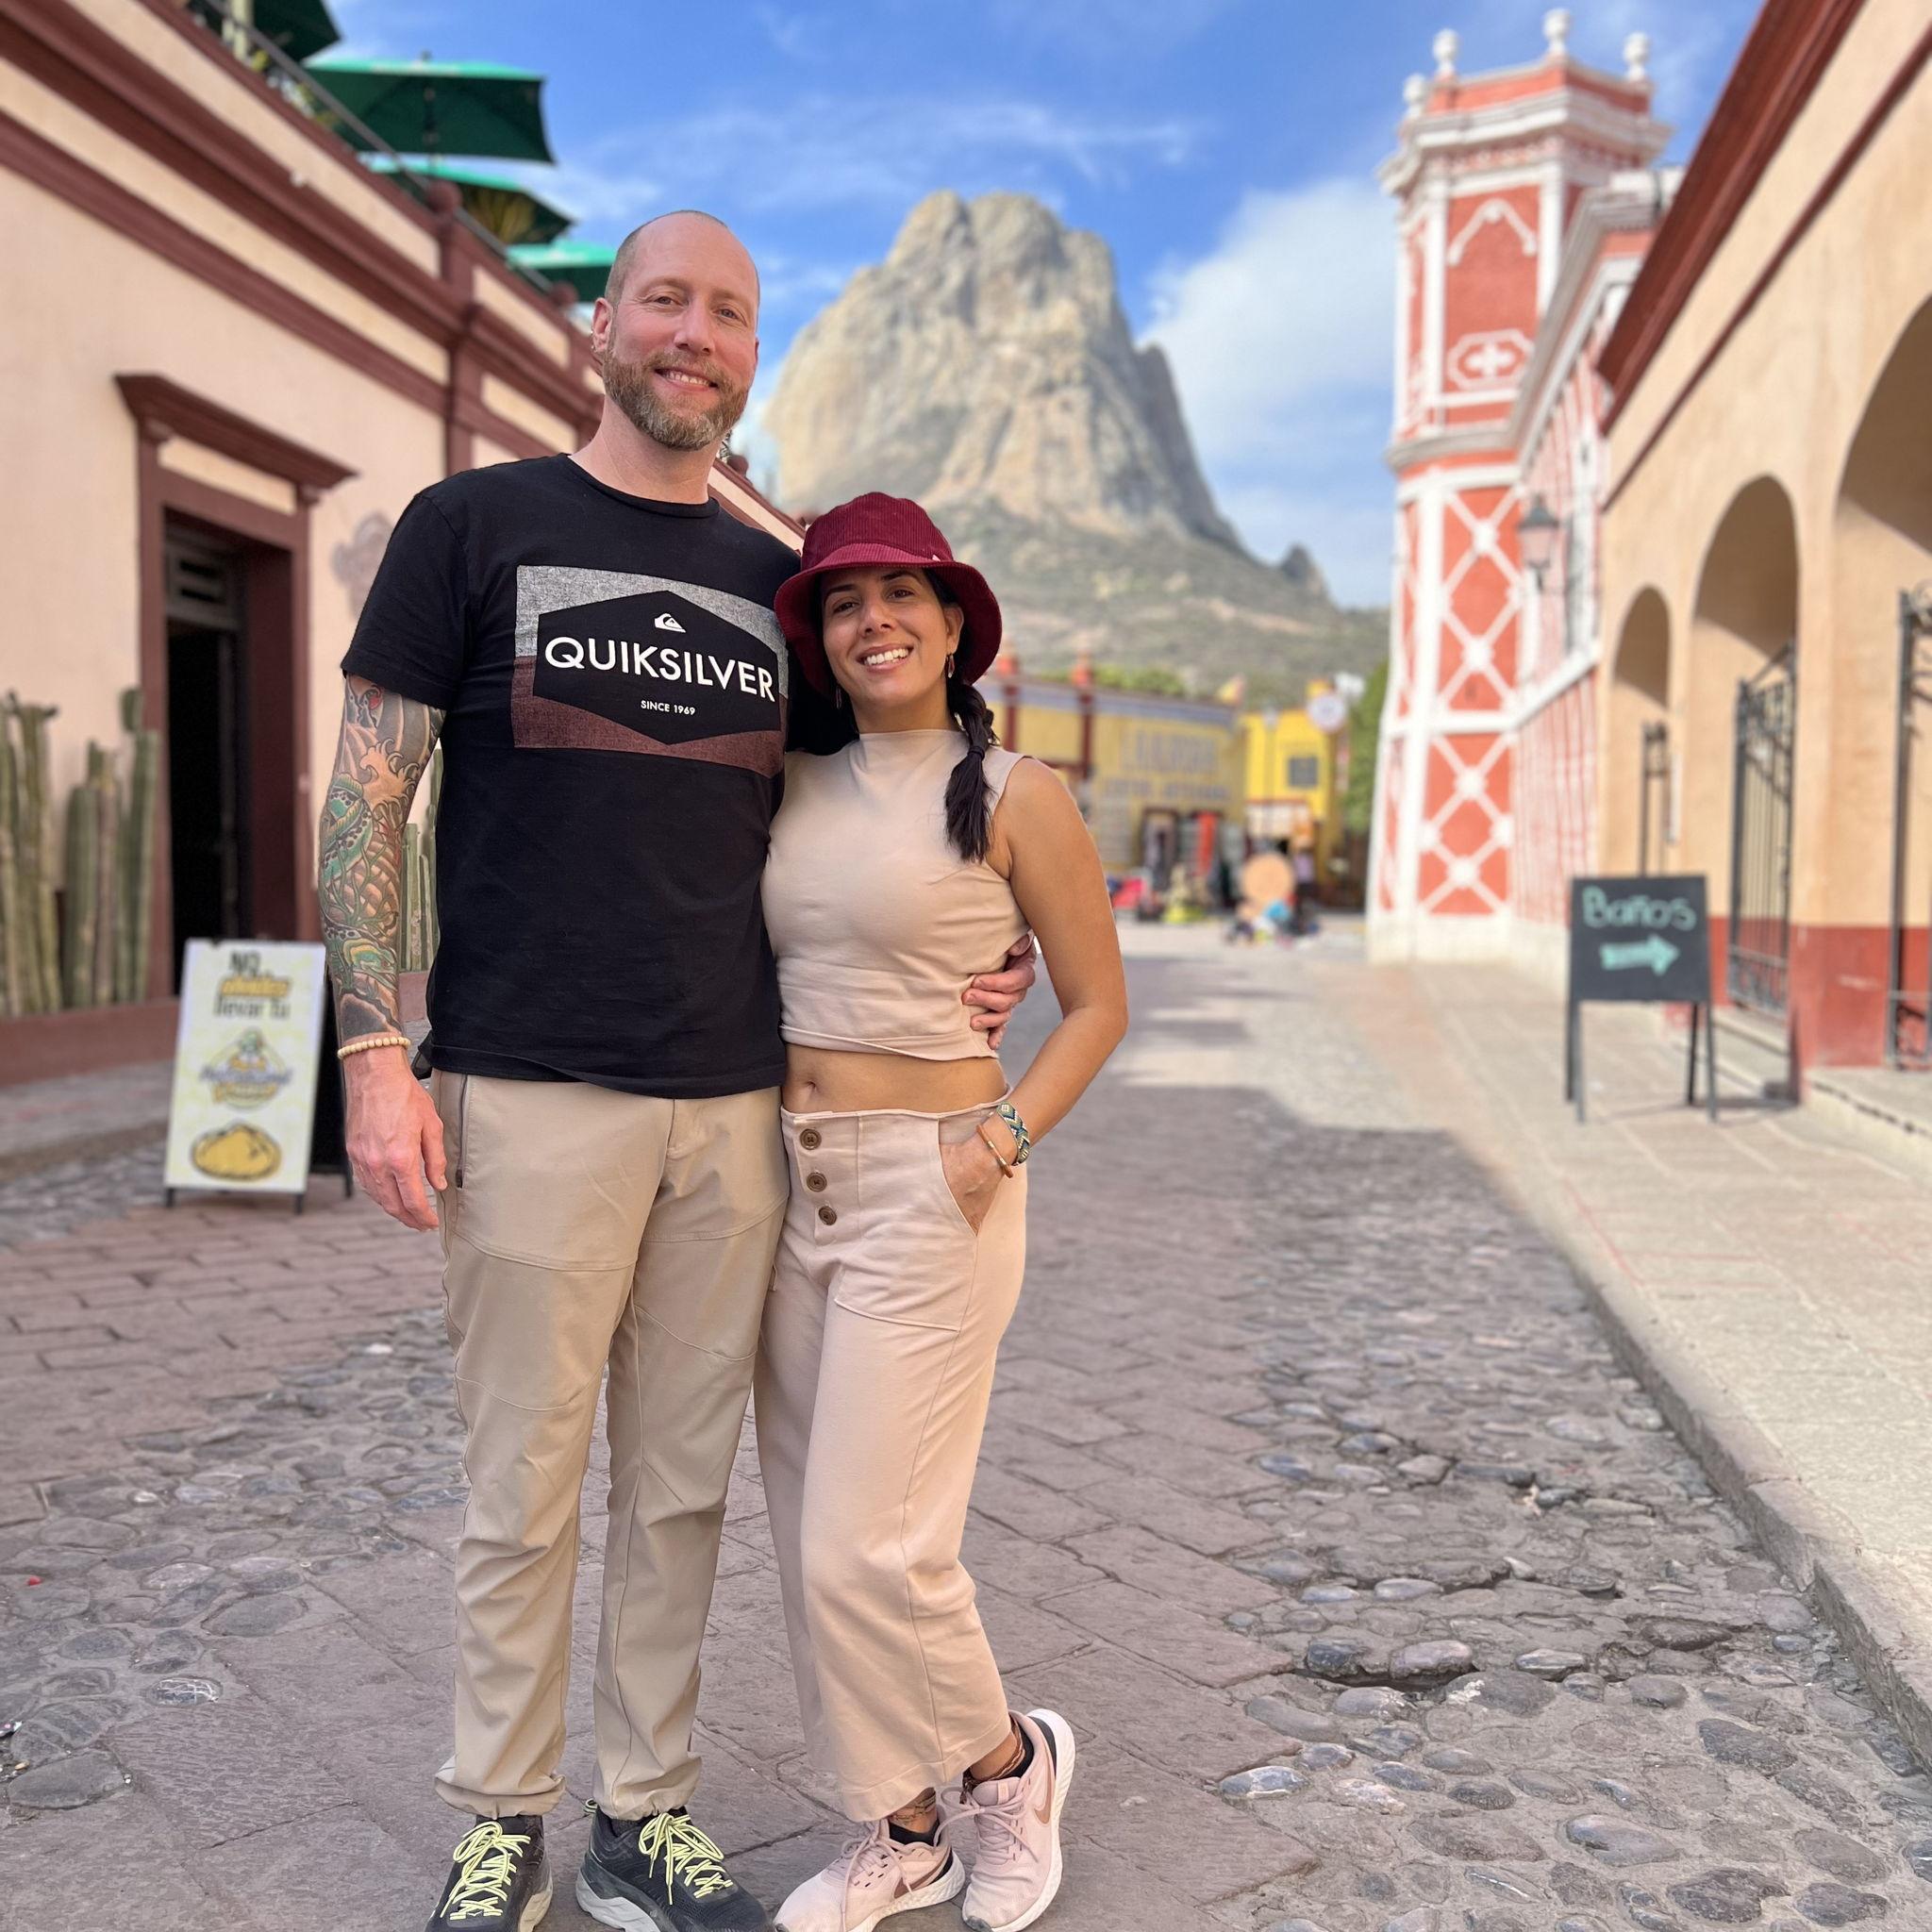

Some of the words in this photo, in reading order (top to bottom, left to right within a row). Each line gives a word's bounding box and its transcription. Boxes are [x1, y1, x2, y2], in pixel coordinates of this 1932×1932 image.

[544, 636, 775, 702] QUIKSILVER
[641, 699, 671, 712] SINCE
[674, 704, 696, 716] 1969
